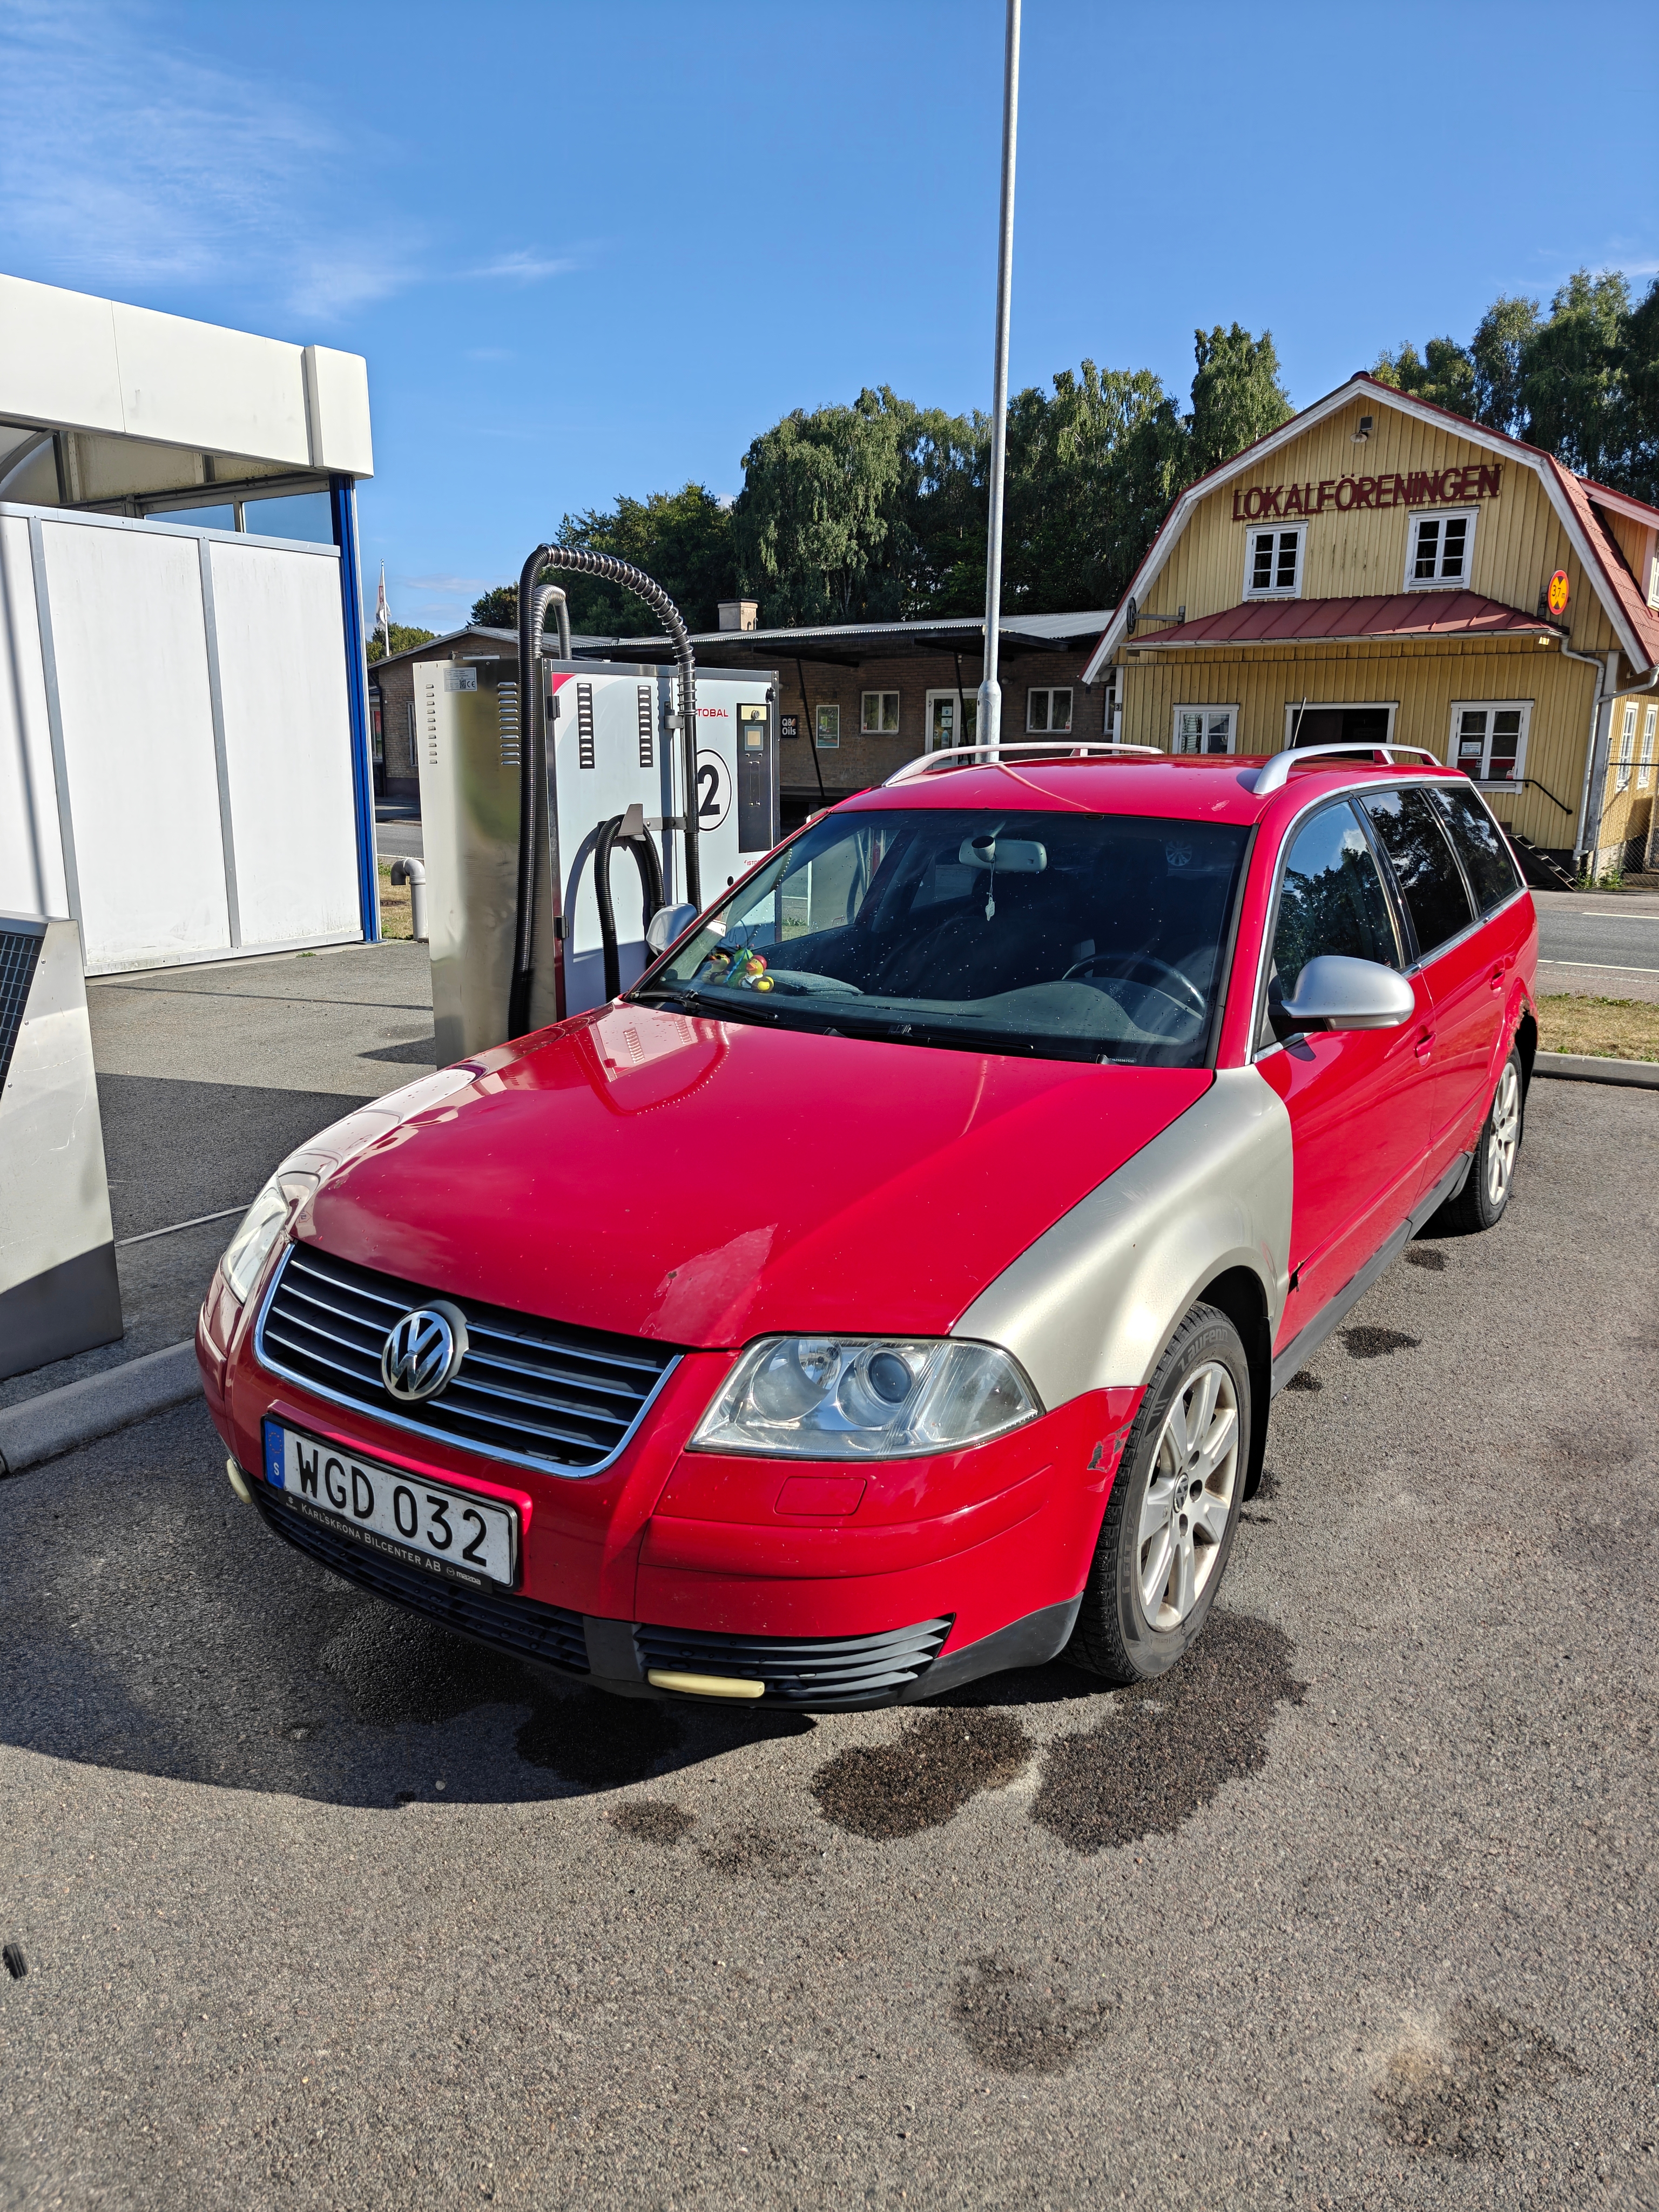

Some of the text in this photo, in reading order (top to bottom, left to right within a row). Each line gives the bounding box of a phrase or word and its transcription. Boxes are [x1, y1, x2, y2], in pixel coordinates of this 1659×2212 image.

[1232, 463, 1502, 520] LOKALFÖRENINGEN
[1552, 585, 1561, 599] 3,7
[697, 709, 729, 717] TOBAL
[782, 718, 792, 726] Q8
[782, 726, 796, 735] Oils
[698, 764, 720, 817] 2
[273, 1462, 280, 1476] S
[296, 1441, 487, 1567] WGD 032
[301, 1503, 441, 1572] KARLSKRONA BILCENTER AB
